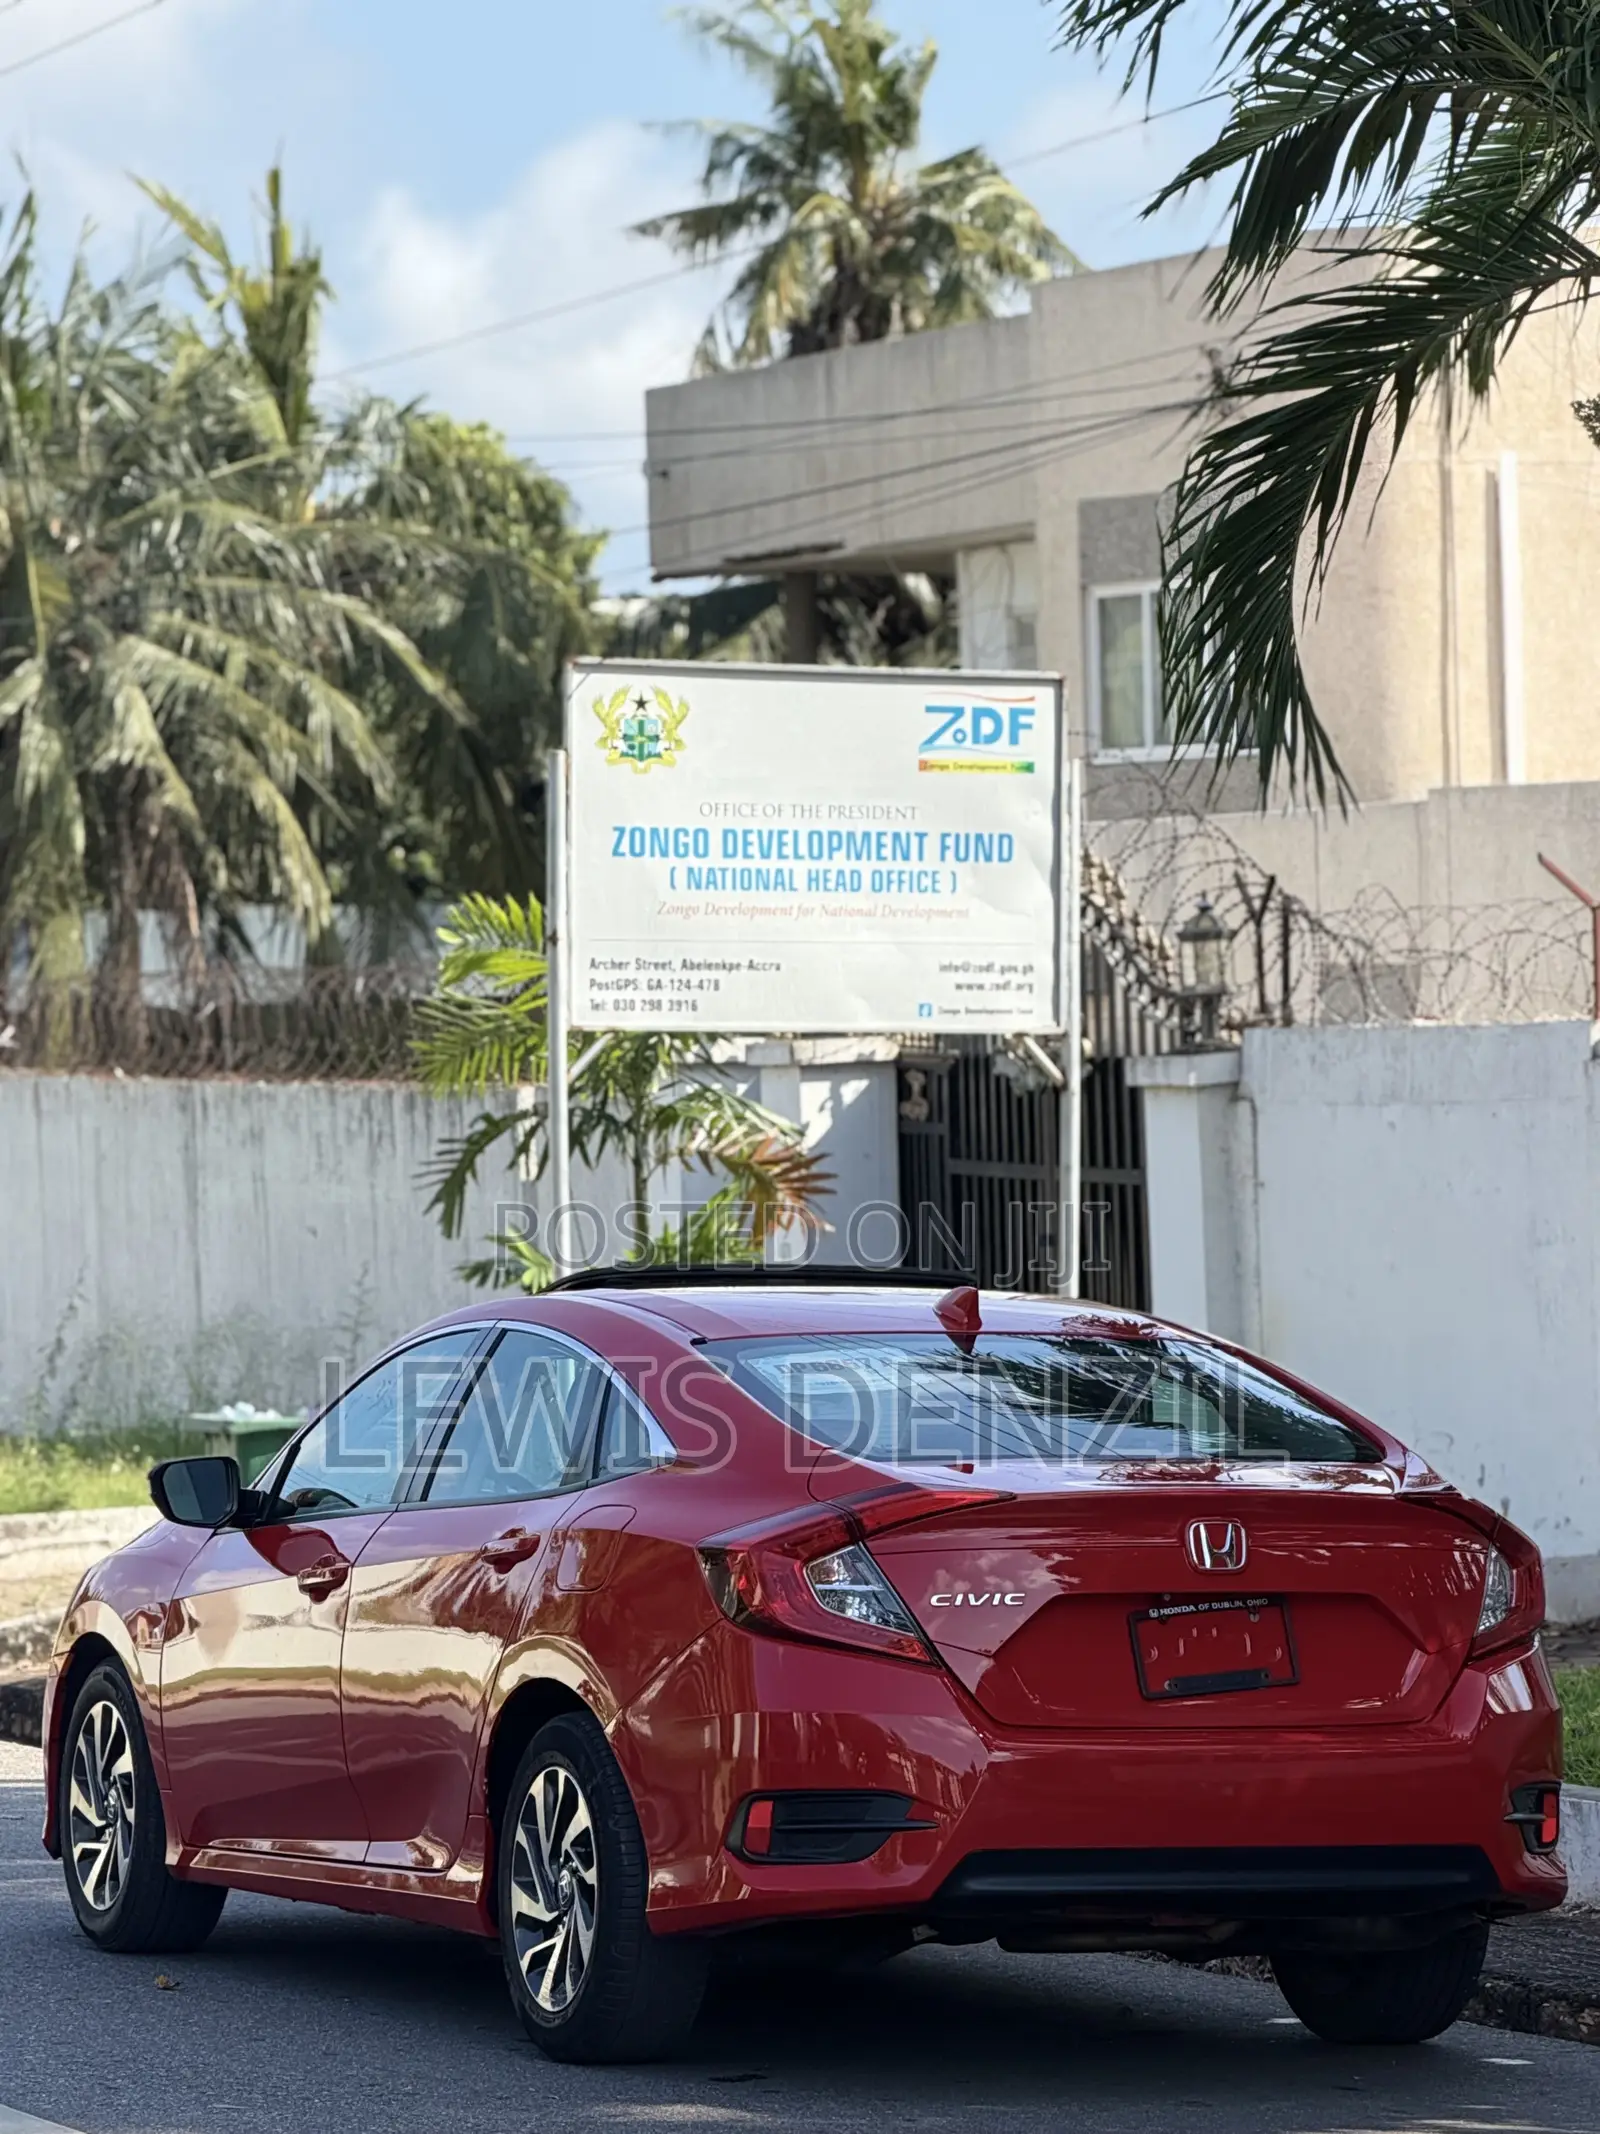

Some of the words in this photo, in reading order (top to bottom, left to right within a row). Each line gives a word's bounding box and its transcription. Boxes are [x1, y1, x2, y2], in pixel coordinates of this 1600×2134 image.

[699, 802, 758, 818] OFFICE
[762, 803, 785, 818] OF
[789, 804, 823, 820] THE
[828, 804, 919, 820] PRESIDENT
[611, 826, 710, 859] ZONGO
[722, 828, 929, 862] DEVELOPMENT
[939, 832, 1014, 863] FUND
[687, 866, 798, 892] NATIONAL
[807, 868, 862, 893] HEAD
[871, 869, 941, 894] OFFICE
[657, 901, 700, 918] Zongo
[704, 902, 793, 920] Development
[793, 903, 816, 921] for
[819, 904, 878, 919] National
[881, 905, 970, 922] Development
[588, 957, 631, 971] Archer
[635, 957, 677, 973] Street,
[612, 998, 636, 1011] 030
[930, 1592, 1026, 1607] CIVIC
[1160, 1605, 1197, 1616] HONDA
[1247, 1598, 1268, 1607] OHIO
